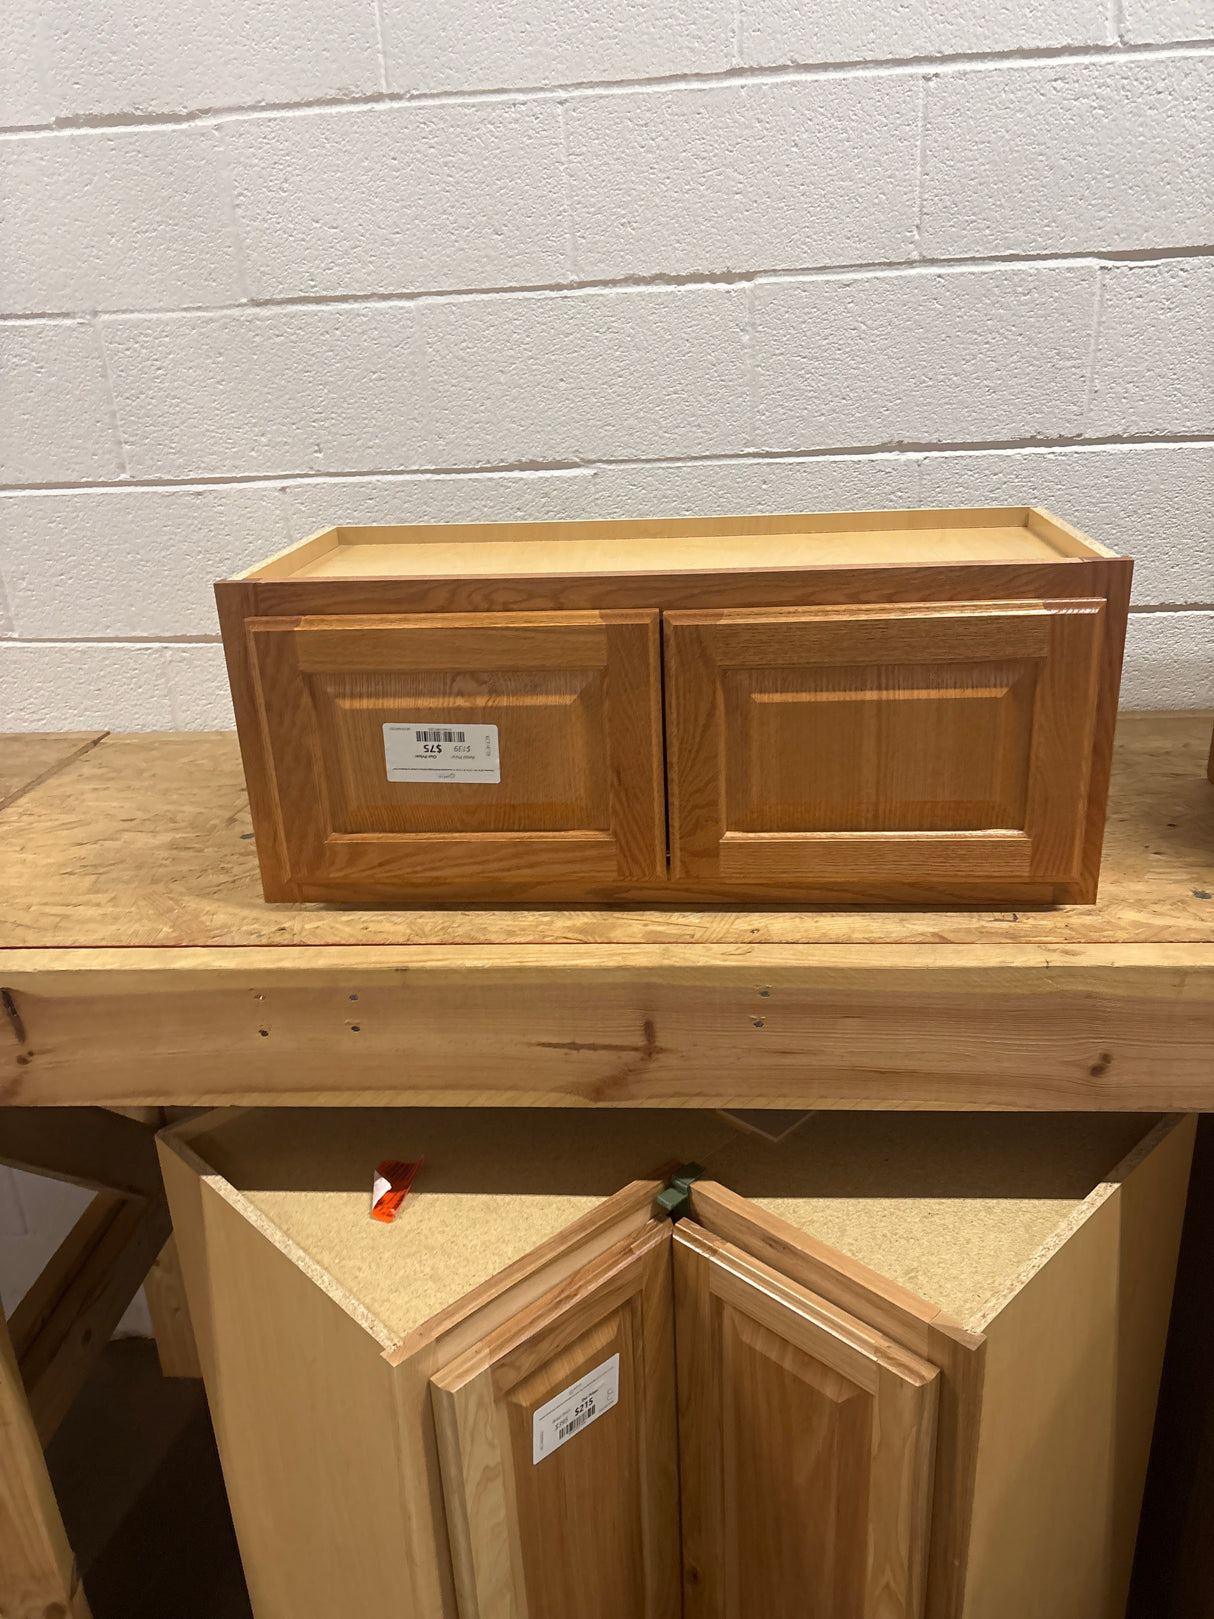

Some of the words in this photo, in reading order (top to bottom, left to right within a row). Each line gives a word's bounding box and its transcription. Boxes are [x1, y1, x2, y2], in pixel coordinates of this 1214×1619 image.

[424, 744, 443, 754] $75
[453, 745, 471, 753] $139
[574, 1397, 594, 1417] $215
